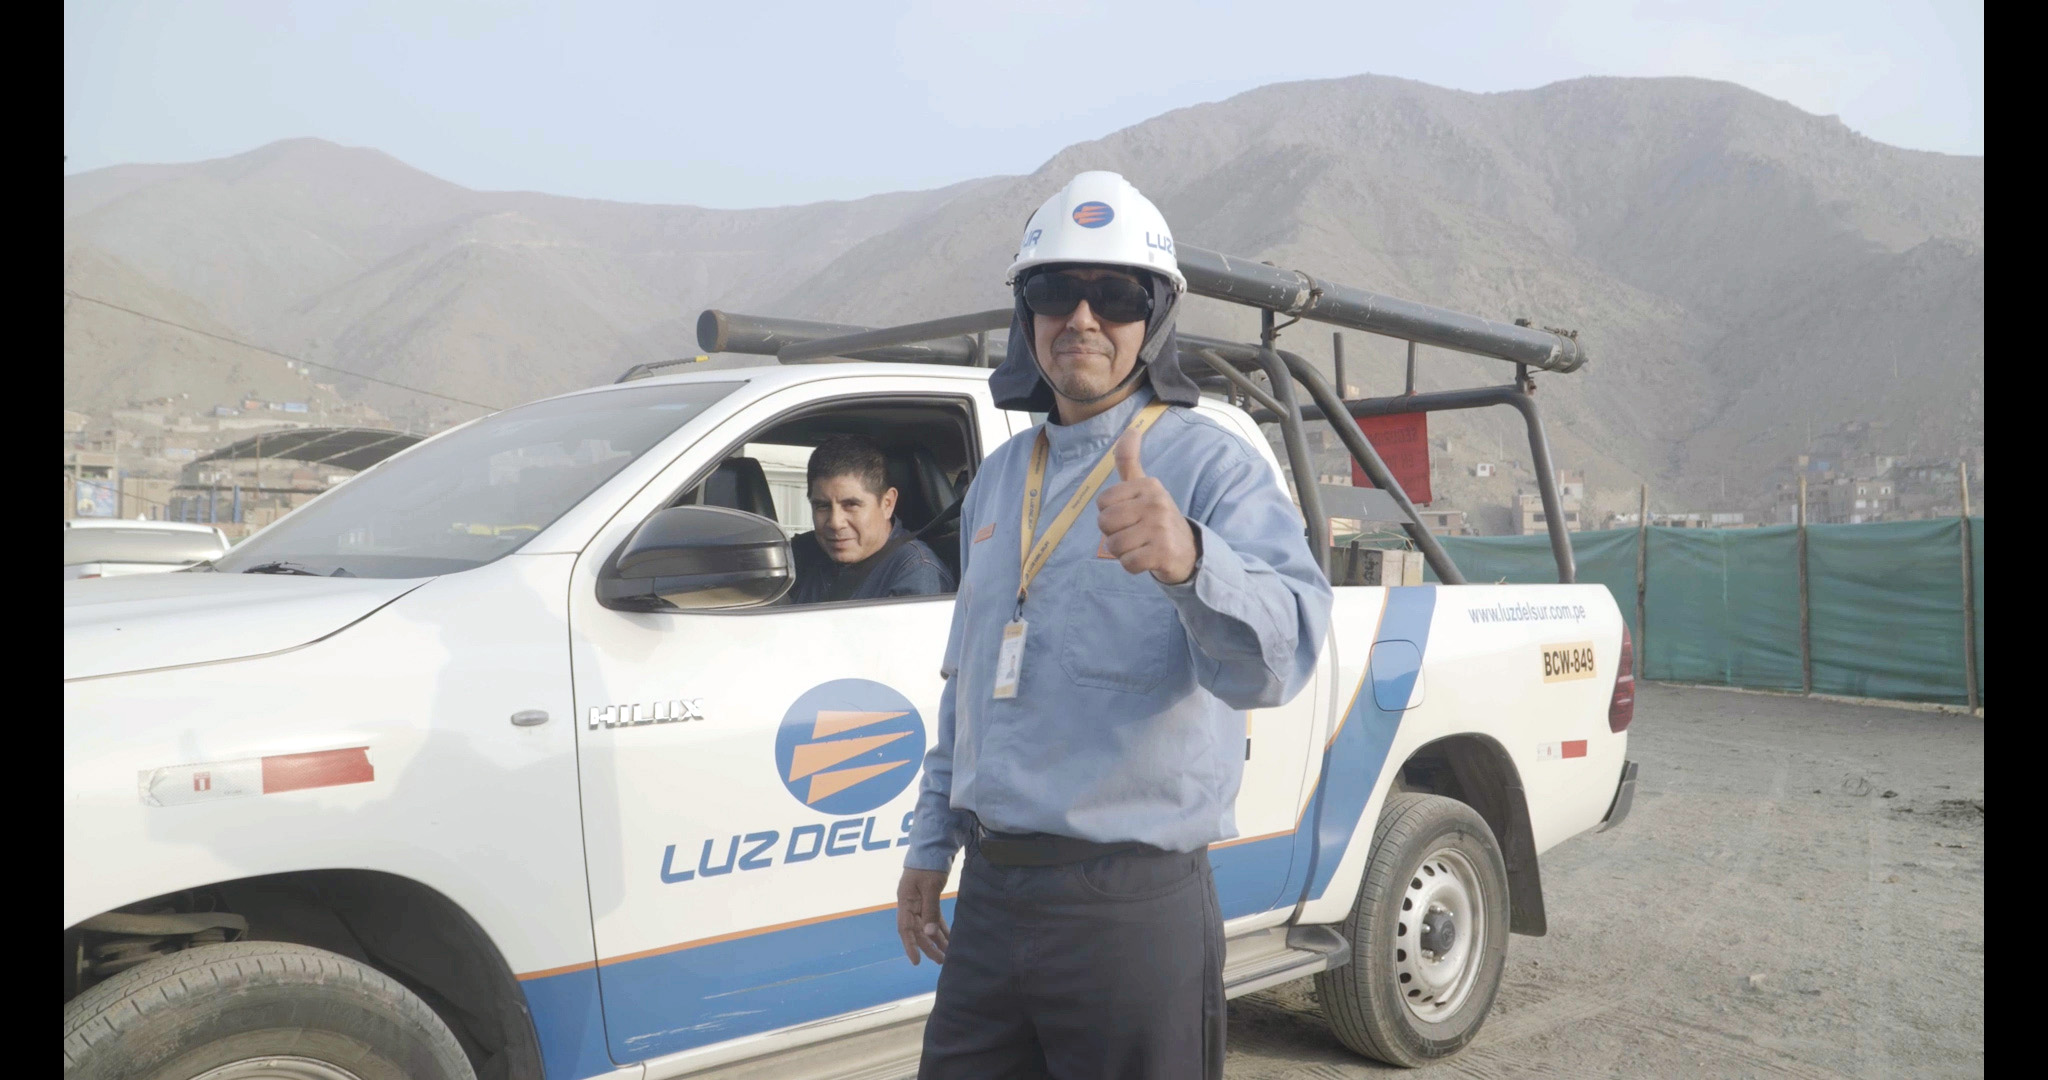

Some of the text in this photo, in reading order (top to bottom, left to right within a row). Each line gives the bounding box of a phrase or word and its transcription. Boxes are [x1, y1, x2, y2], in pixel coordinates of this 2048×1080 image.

[1145, 231, 1173, 255] LUZ
[1468, 601, 1586, 624] www.luzdelsur.com.pe
[1543, 647, 1594, 676] BCW-849
[588, 698, 704, 730] HILUX
[660, 829, 780, 884] LUZ
[783, 816, 891, 864] DEL
